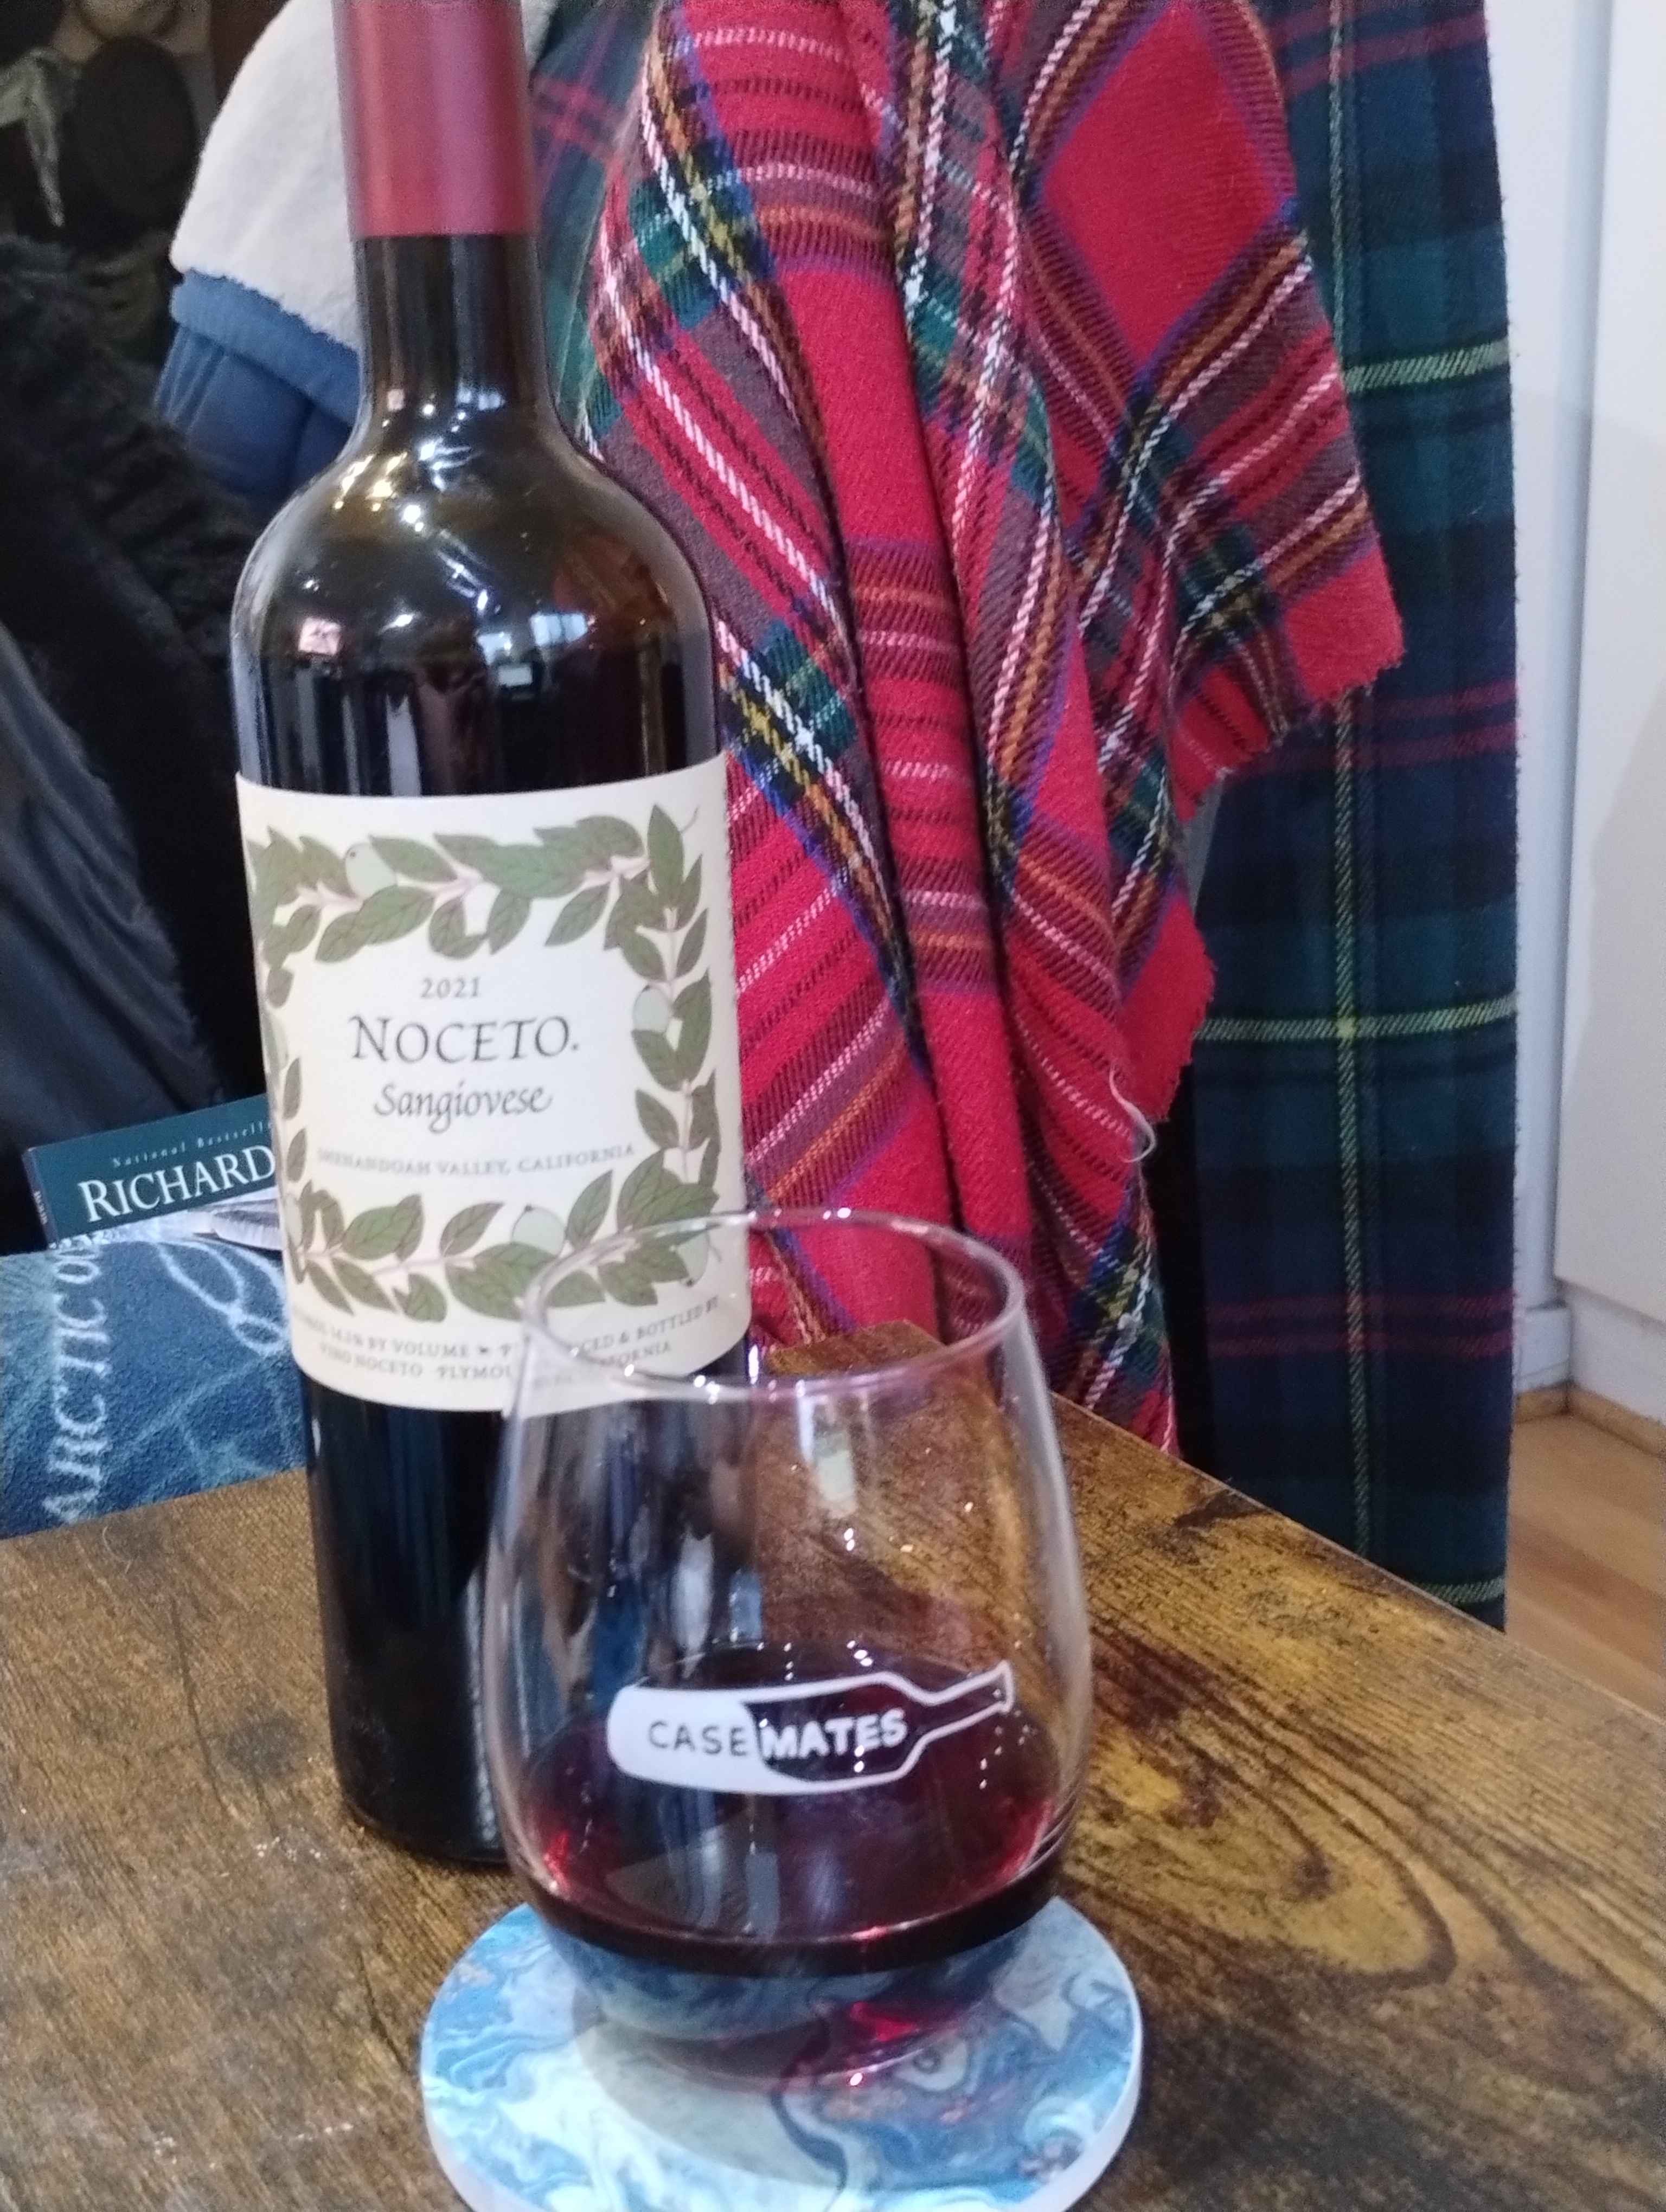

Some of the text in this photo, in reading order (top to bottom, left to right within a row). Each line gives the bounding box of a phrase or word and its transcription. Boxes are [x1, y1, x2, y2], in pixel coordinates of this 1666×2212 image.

[420, 976, 479, 999] 2021
[374, 1079, 553, 1134] Sangiovese
[112, 1140, 185, 1167] National
[517, 1142, 635, 1173] CALIFORNIA
[77, 1144, 276, 1222] RICHARD
[392, 1336, 471, 1359] VOLUME
[636, 1308, 703, 1340] BOTTLED
[354, 1352, 424, 1378] NOCETO
